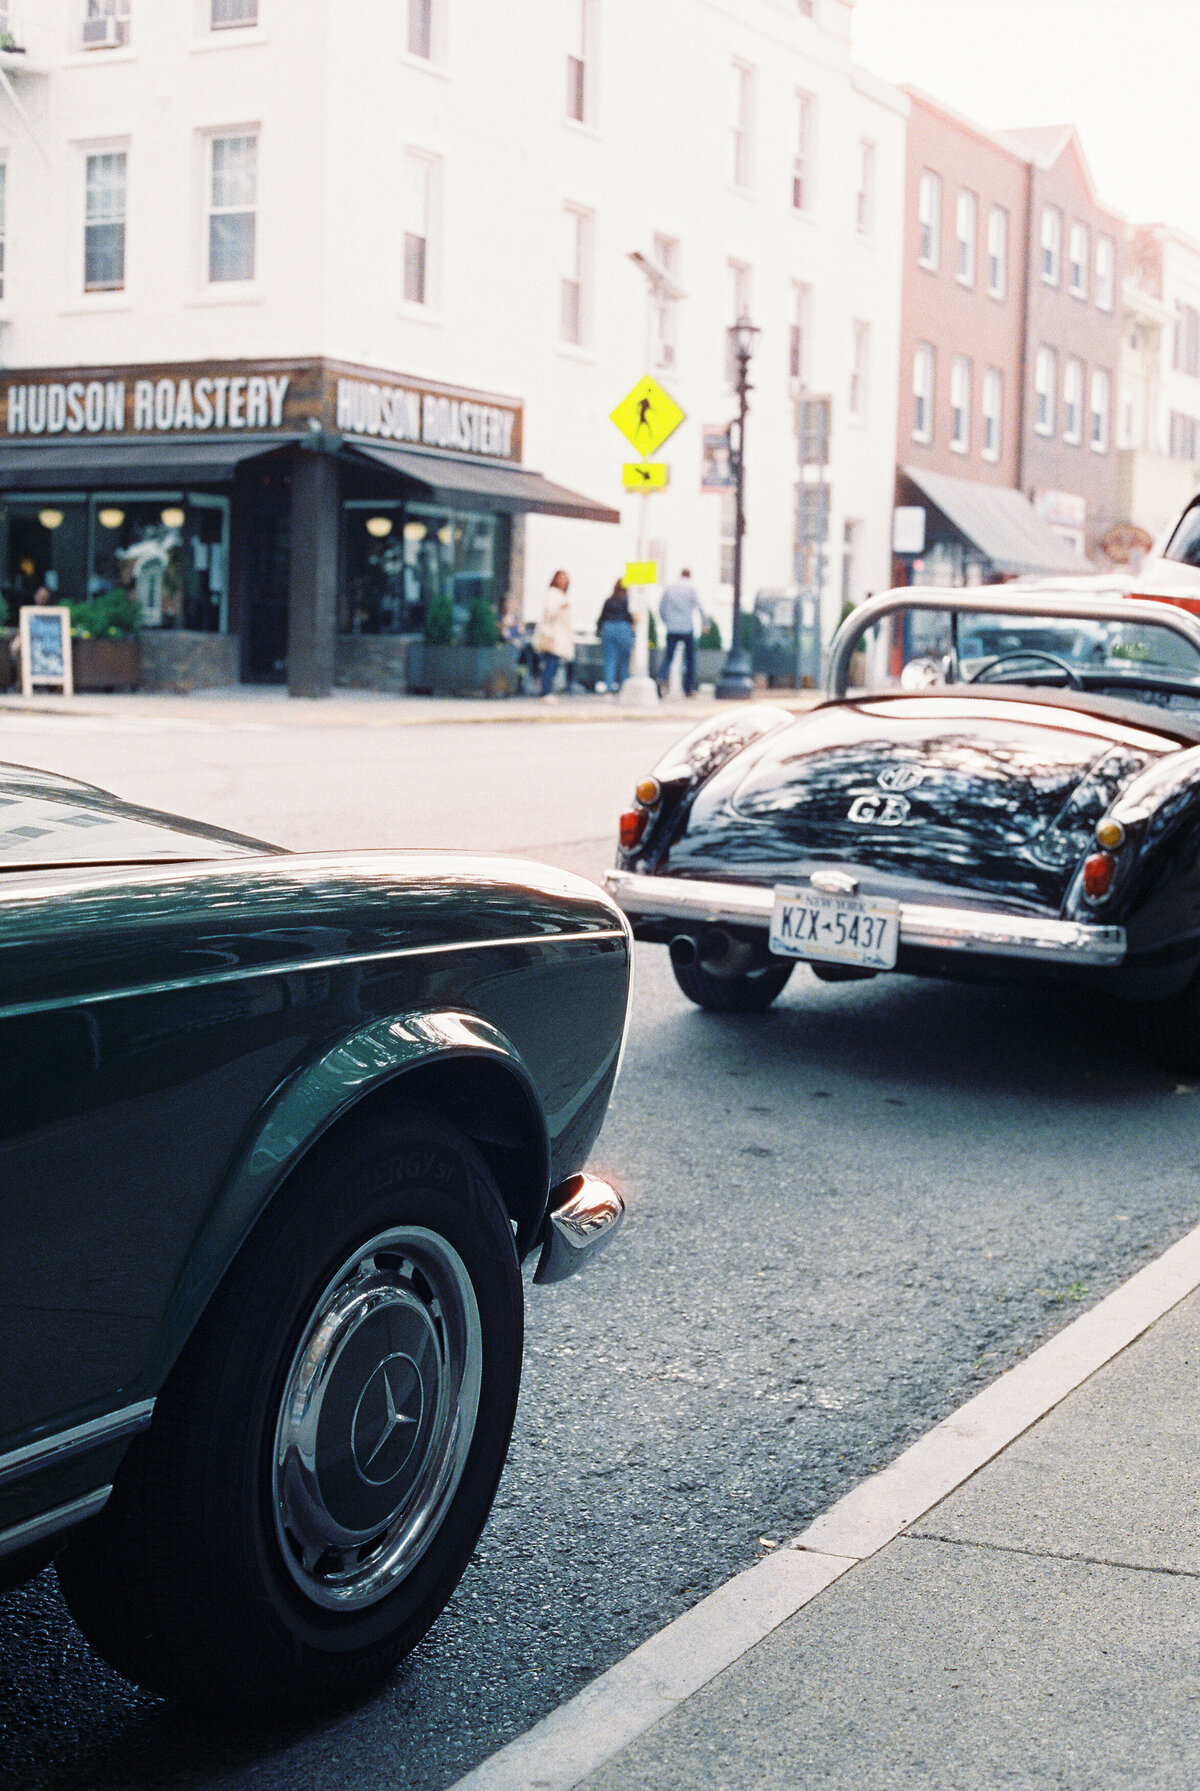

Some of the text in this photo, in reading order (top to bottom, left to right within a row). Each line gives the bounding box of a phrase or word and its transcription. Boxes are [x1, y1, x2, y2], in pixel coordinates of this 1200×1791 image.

[7, 375, 290, 434] HUDSON ROASTERY
[847, 794, 911, 826] GB
